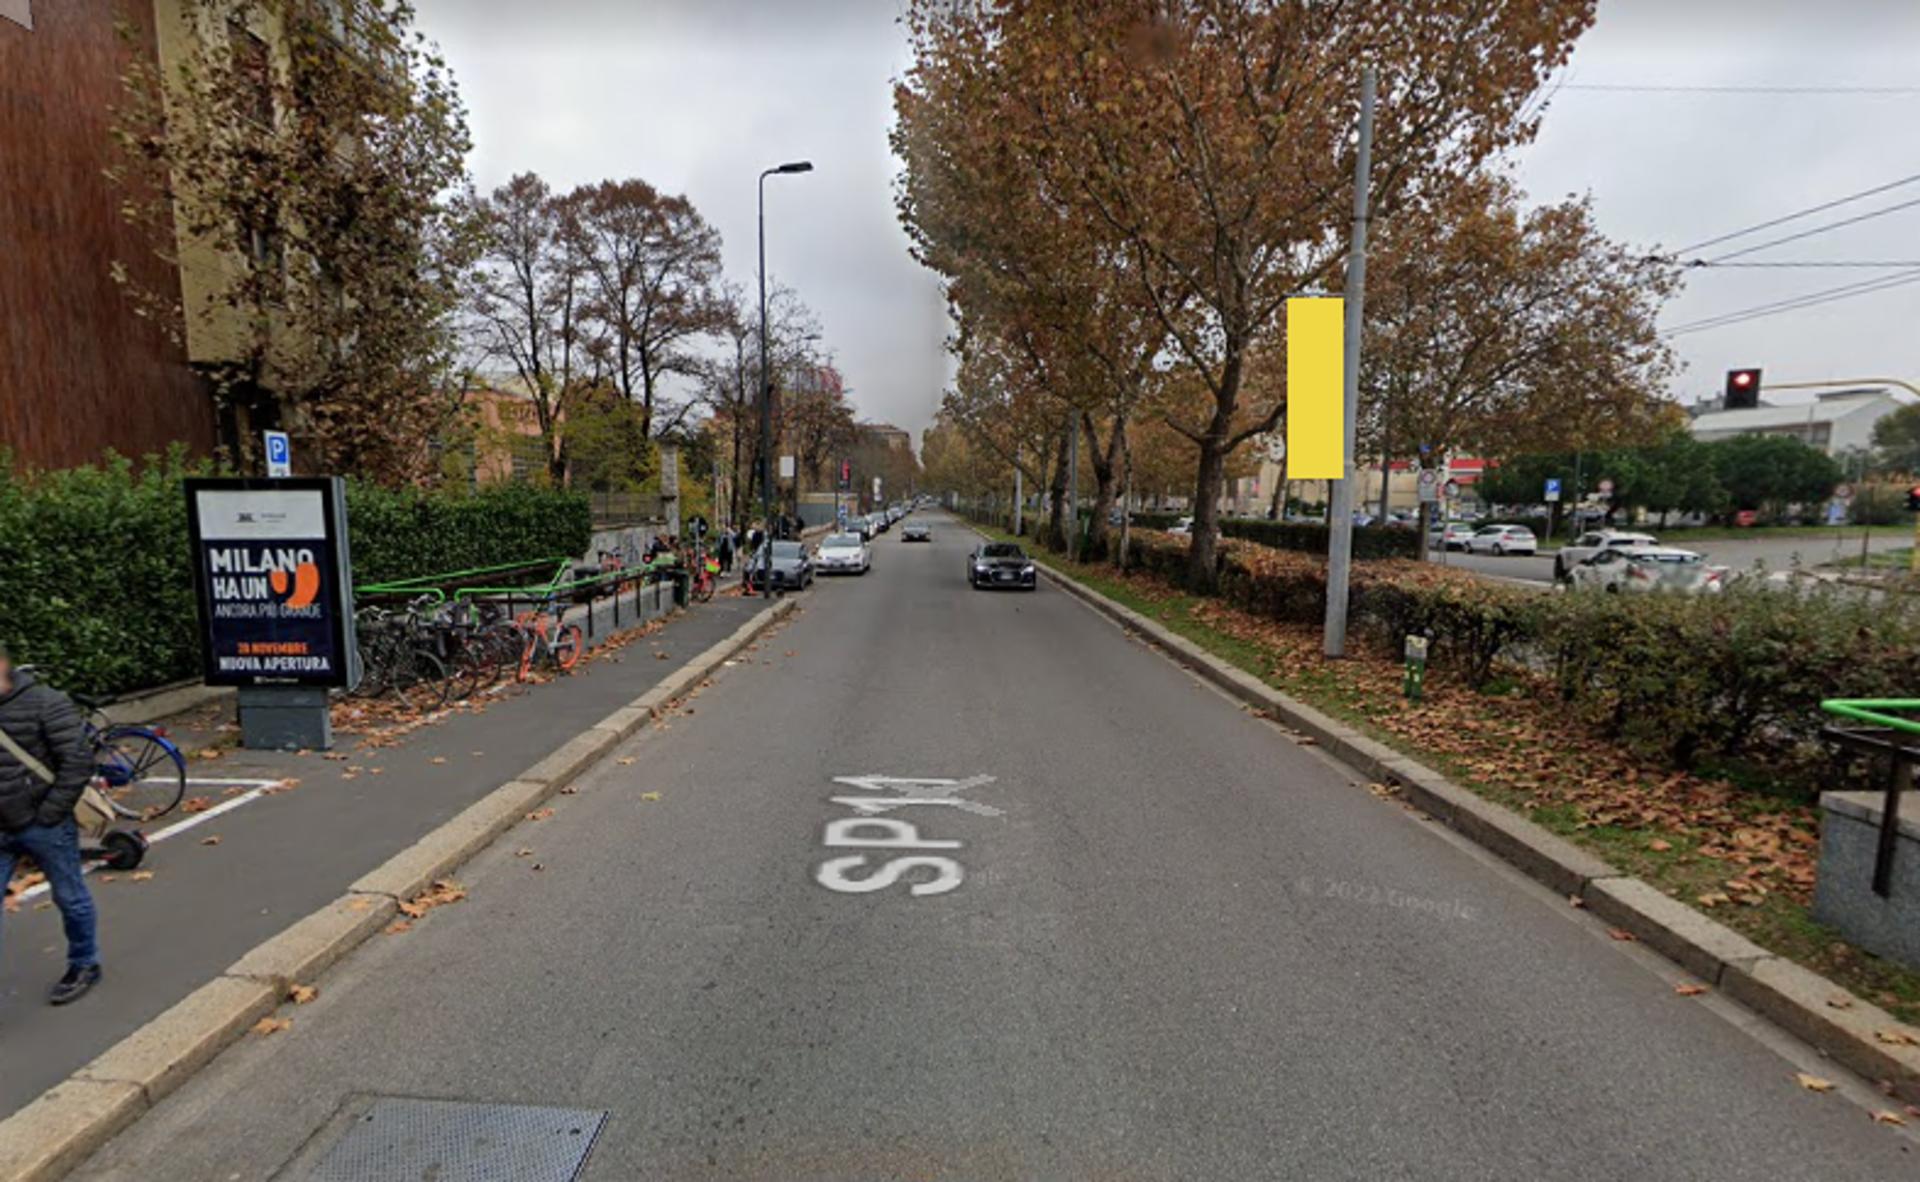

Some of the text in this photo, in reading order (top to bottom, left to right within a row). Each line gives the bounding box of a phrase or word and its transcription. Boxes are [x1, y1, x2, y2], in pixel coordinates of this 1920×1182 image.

[272, 439, 284, 460] P
[209, 548, 314, 573] MILANO
[212, 577, 268, 599] HA UN
[215, 603, 257, 618] ANCORA
[251, 642, 309, 655] NOVEMBRE
[219, 656, 330, 671] NUOVA APERTURA
